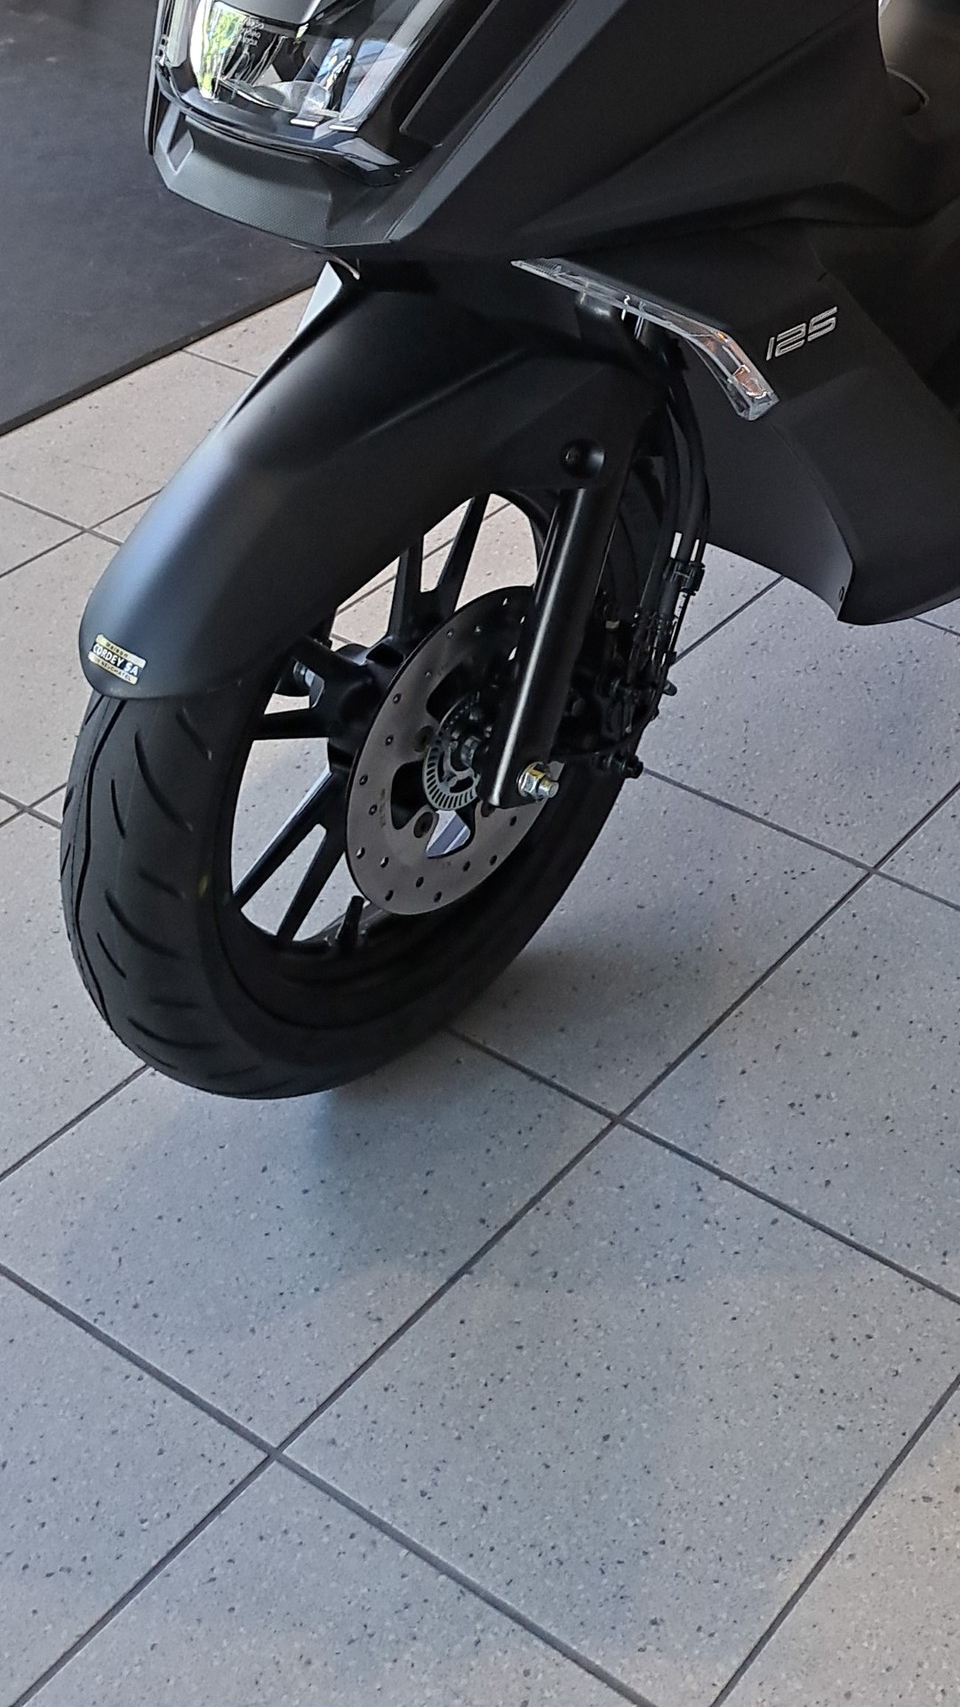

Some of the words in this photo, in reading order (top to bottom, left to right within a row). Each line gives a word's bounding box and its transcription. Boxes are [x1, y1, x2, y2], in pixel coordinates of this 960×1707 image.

[766, 306, 838, 362] 125
[92, 643, 125, 667] CORDEY
[123, 661, 140, 676] SA
